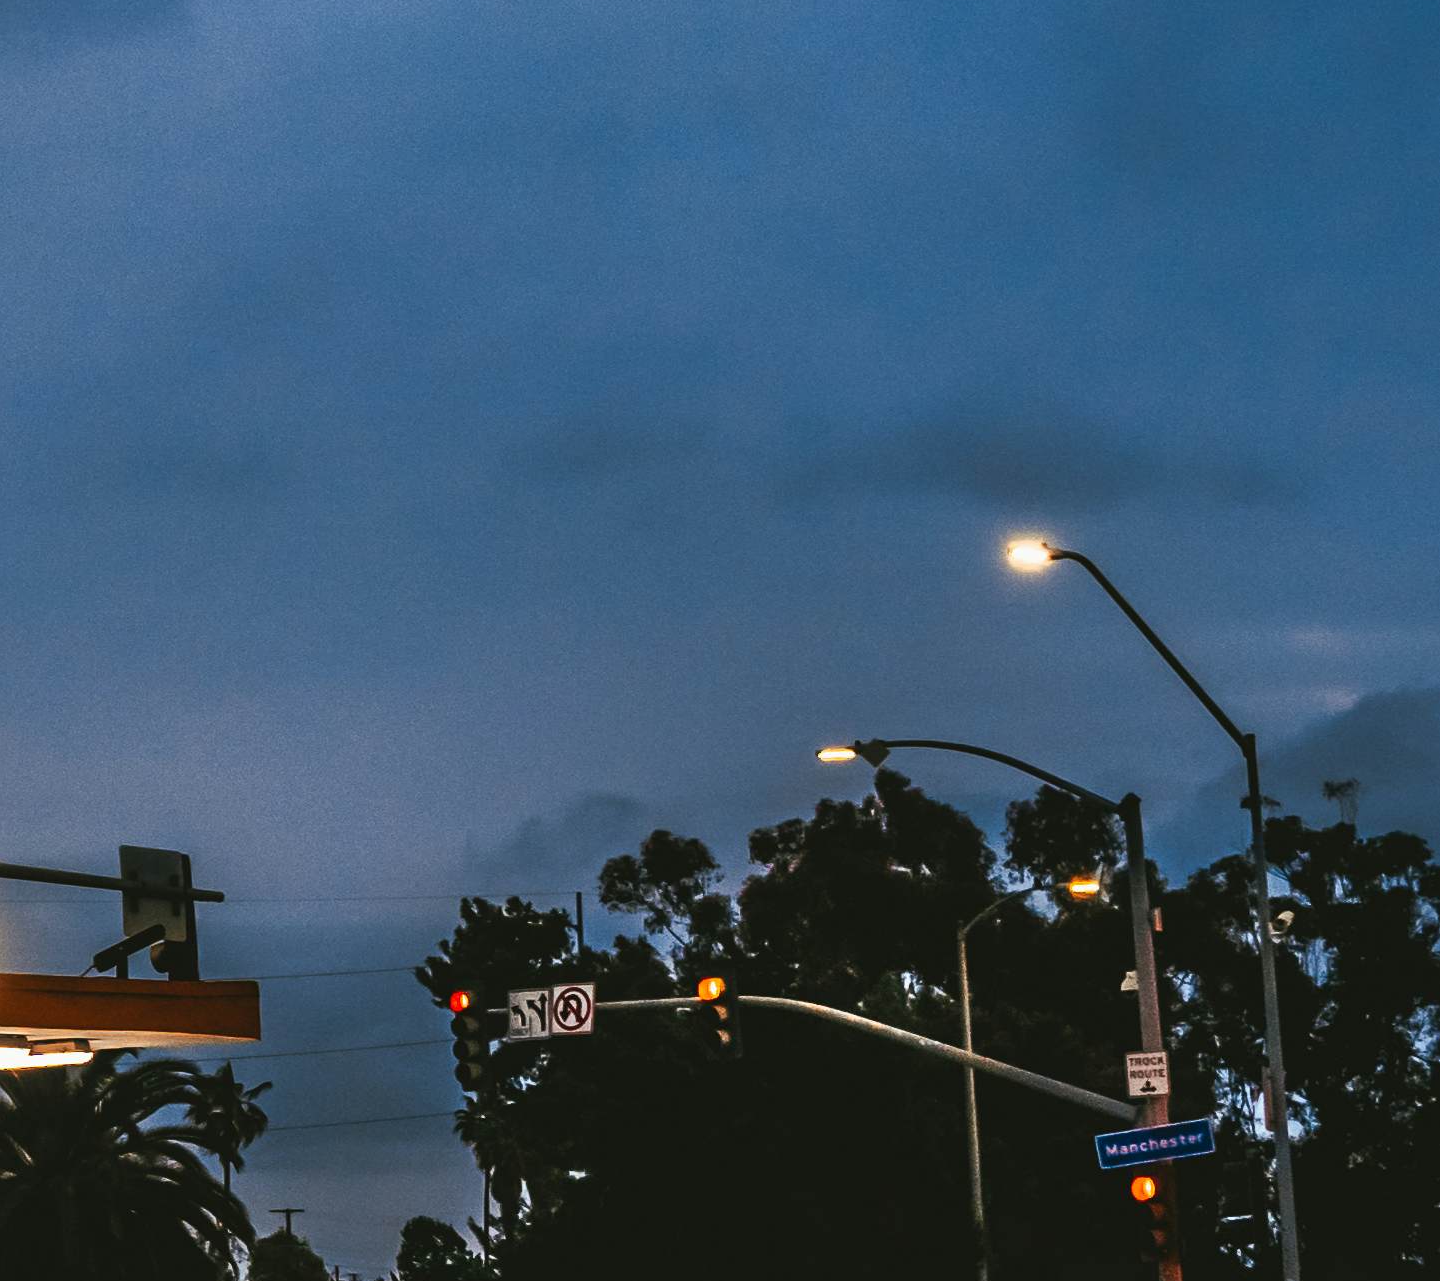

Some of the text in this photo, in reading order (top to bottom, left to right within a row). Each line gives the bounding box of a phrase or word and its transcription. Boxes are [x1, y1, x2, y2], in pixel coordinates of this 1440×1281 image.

[1128, 1056, 1165, 1067] TRUCK
[1129, 1068, 1166, 1079] ROUTE
[1105, 1132, 1204, 1157] Manchester
